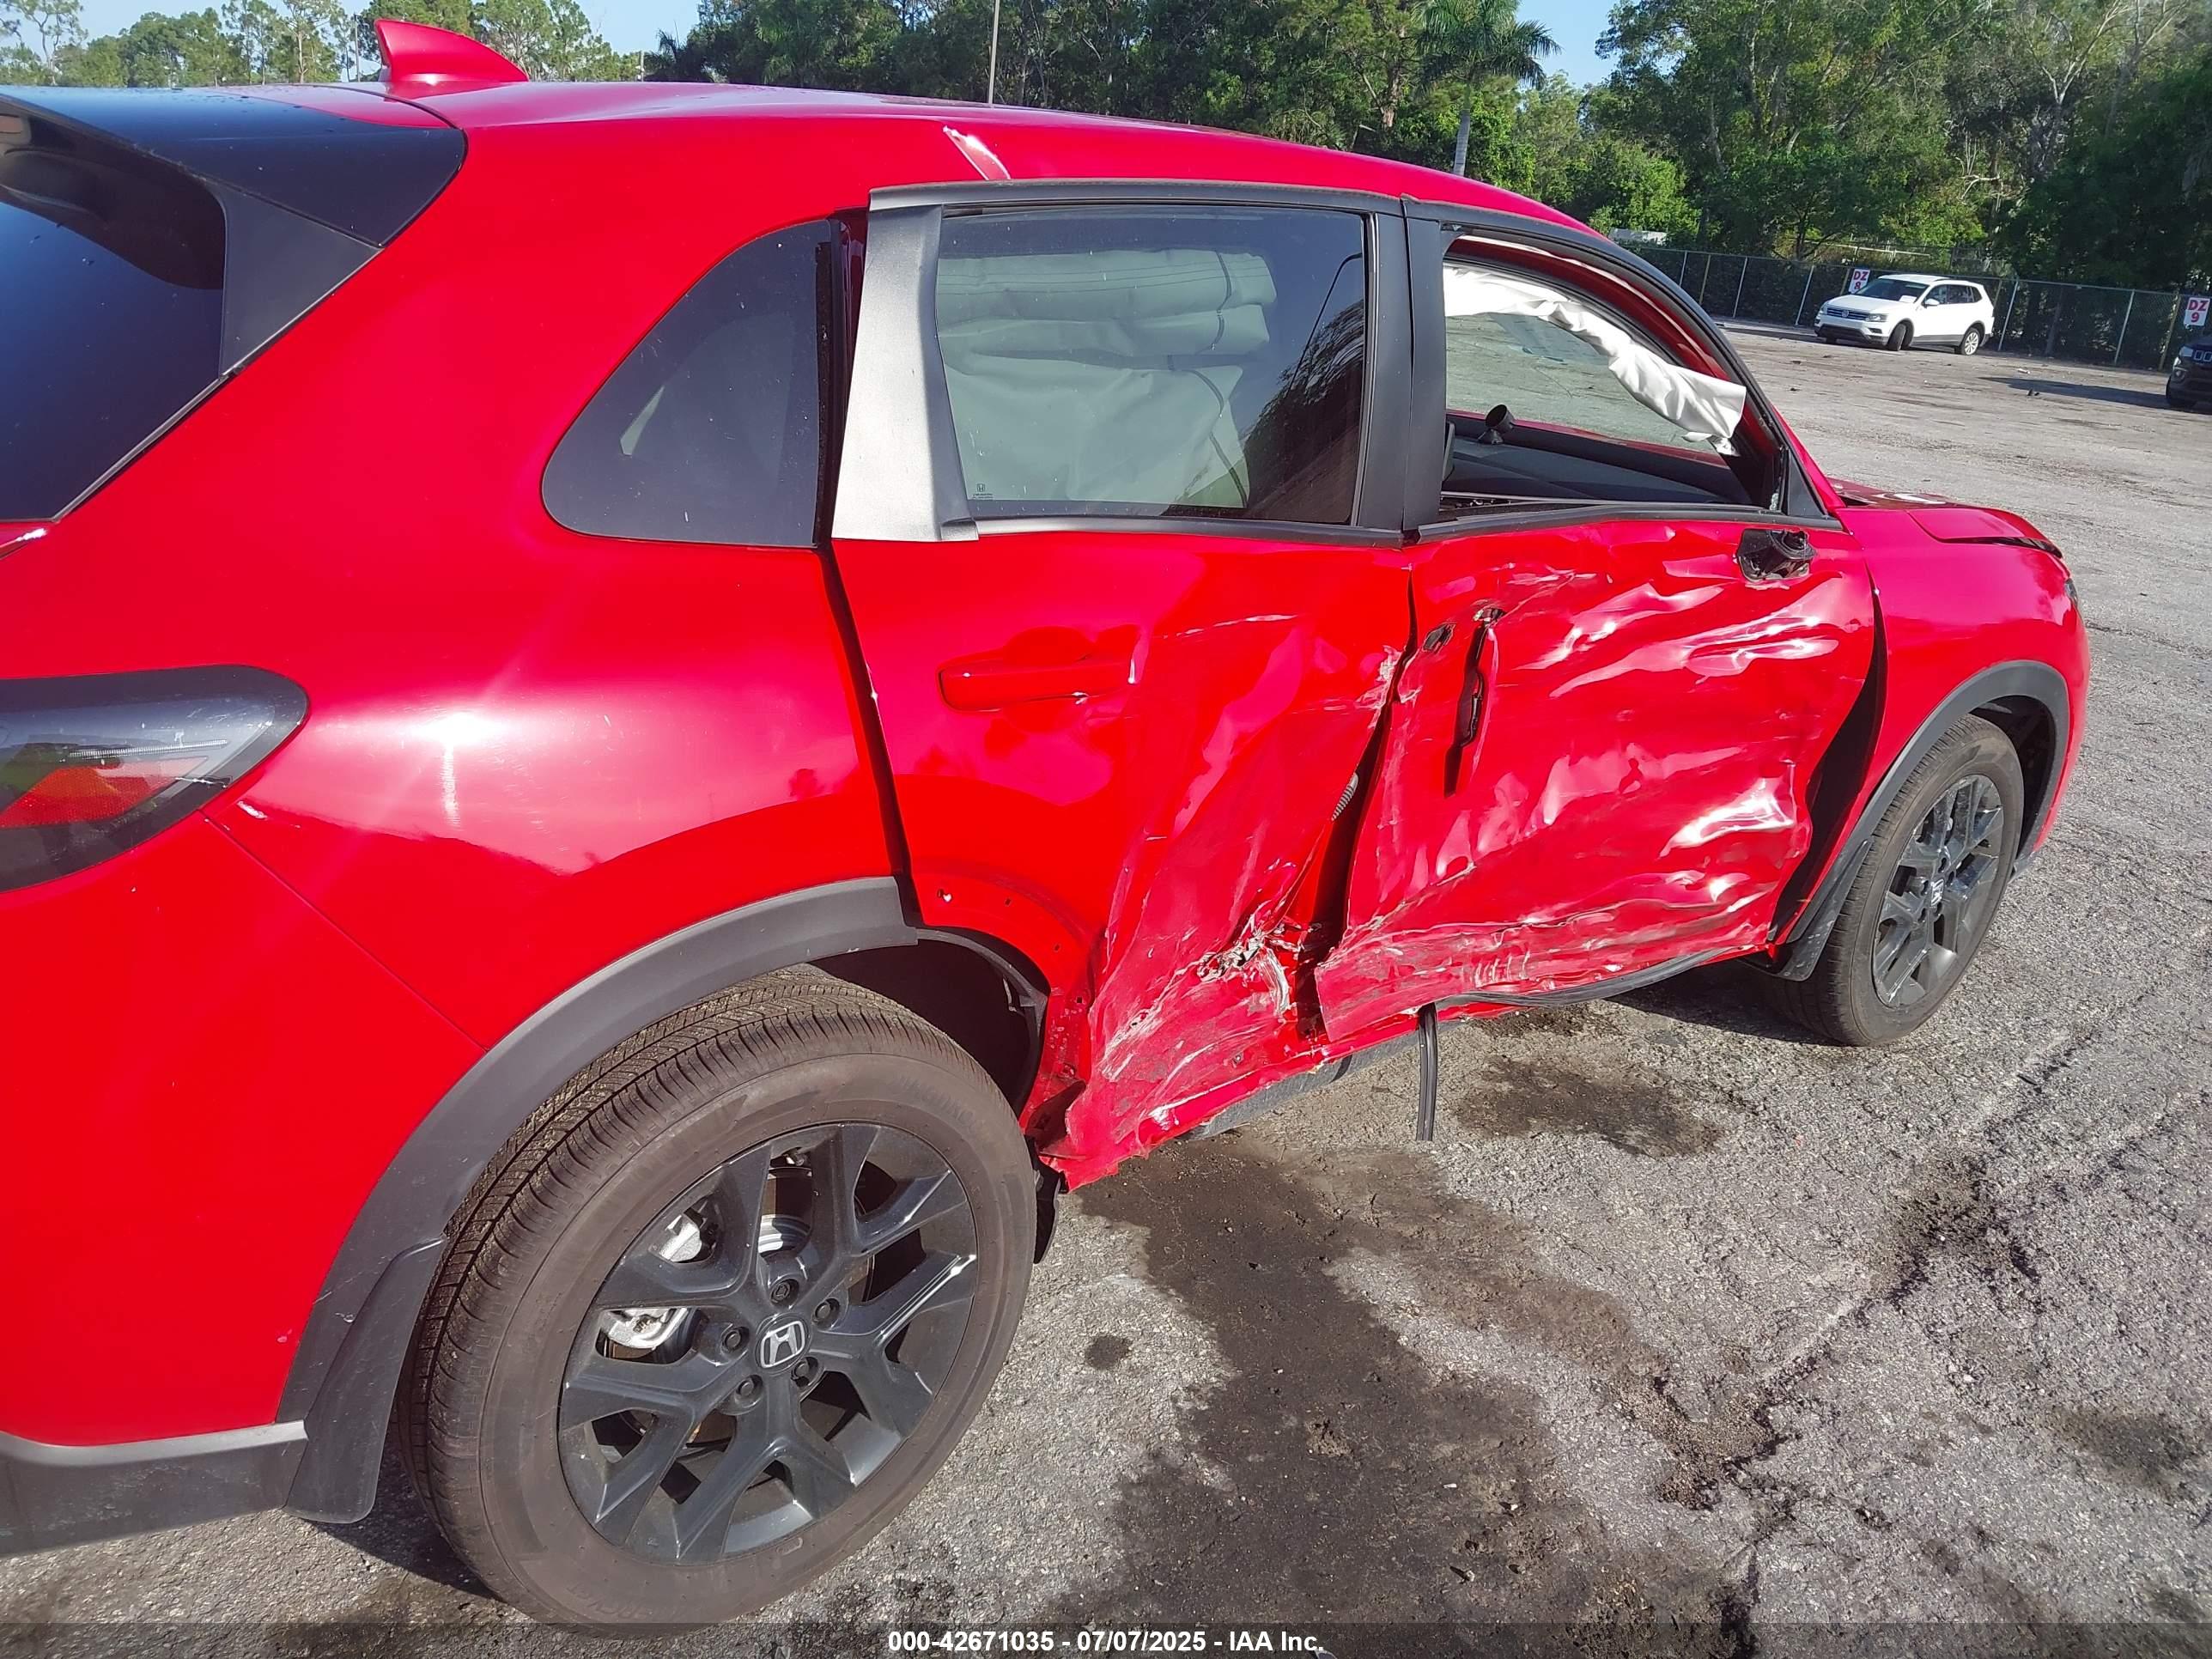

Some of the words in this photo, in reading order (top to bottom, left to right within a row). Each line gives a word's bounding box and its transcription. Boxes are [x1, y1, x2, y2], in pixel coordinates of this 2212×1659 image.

[1853, 270, 1869, 281] DZ
[1854, 281, 1861, 289] 8
[2188, 300, 2209, 311] DZ
[2191, 312, 2200, 323] 9
